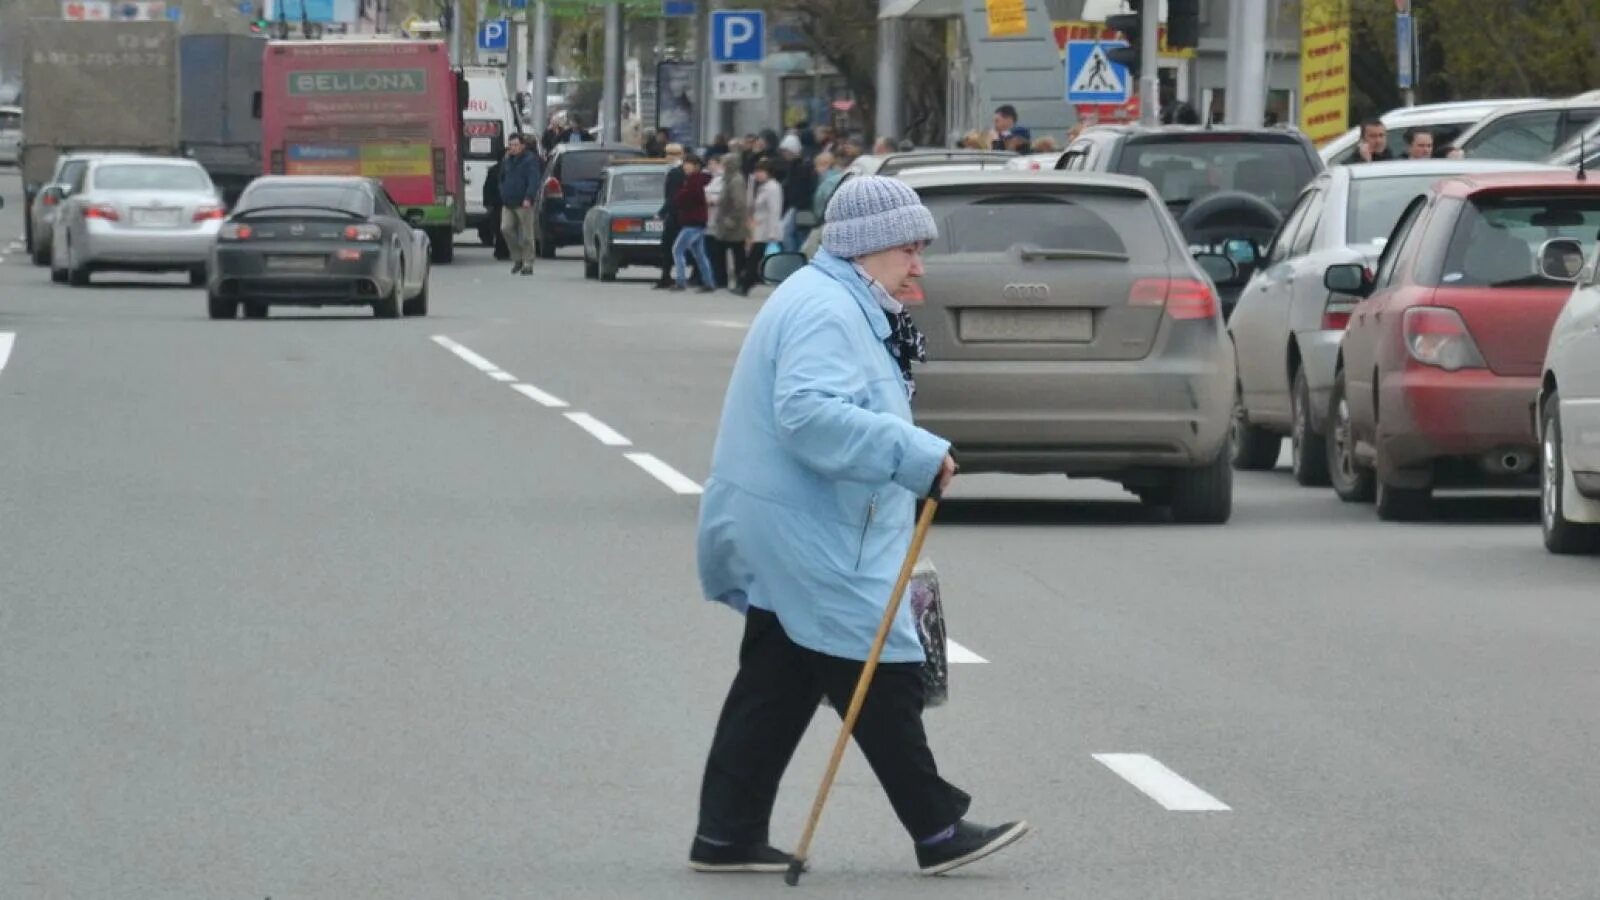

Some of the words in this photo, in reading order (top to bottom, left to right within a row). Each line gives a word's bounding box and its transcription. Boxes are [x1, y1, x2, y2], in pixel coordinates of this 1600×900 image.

[485, 24, 502, 47] P
[724, 16, 754, 57] P
[296, 72, 416, 91] BELLONA
